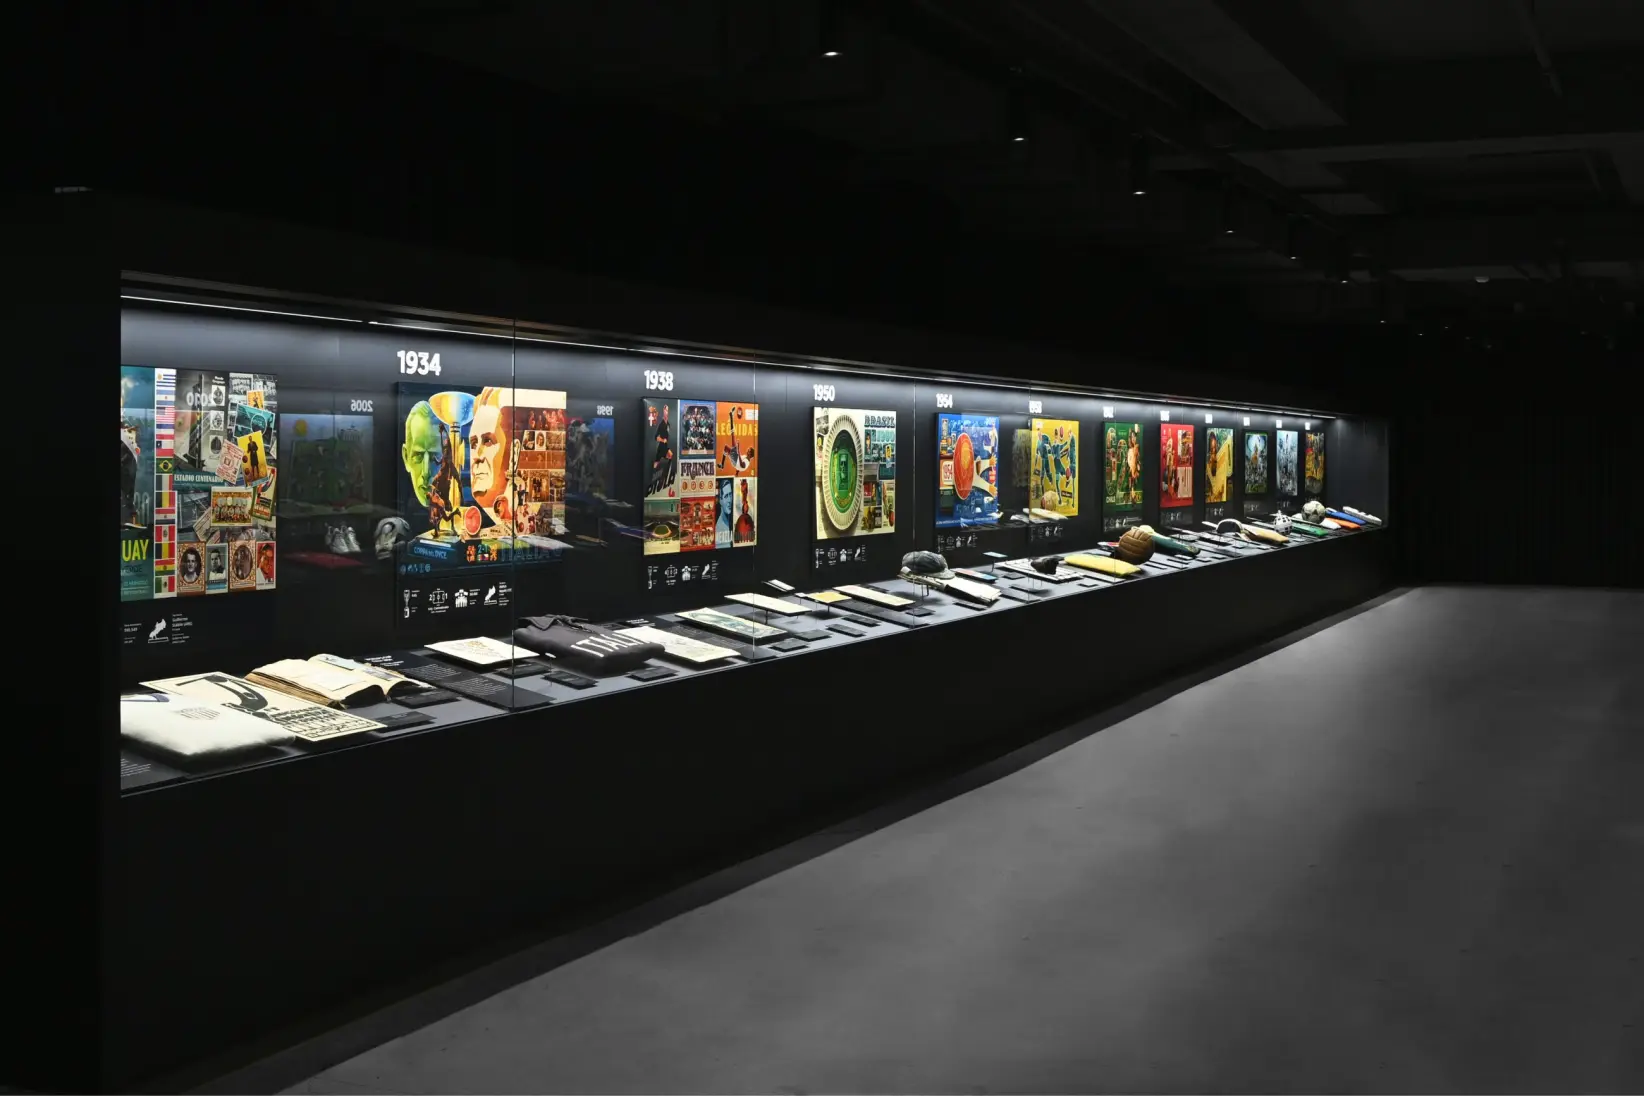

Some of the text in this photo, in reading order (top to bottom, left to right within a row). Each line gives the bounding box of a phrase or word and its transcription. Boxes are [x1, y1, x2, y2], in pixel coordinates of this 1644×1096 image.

[397, 350, 442, 376] 1934
[644, 369, 674, 391] 1938
[813, 383, 836, 402] 1950
[174, 474, 195, 482] ESTADIO
[680, 461, 715, 479] FRANCE
